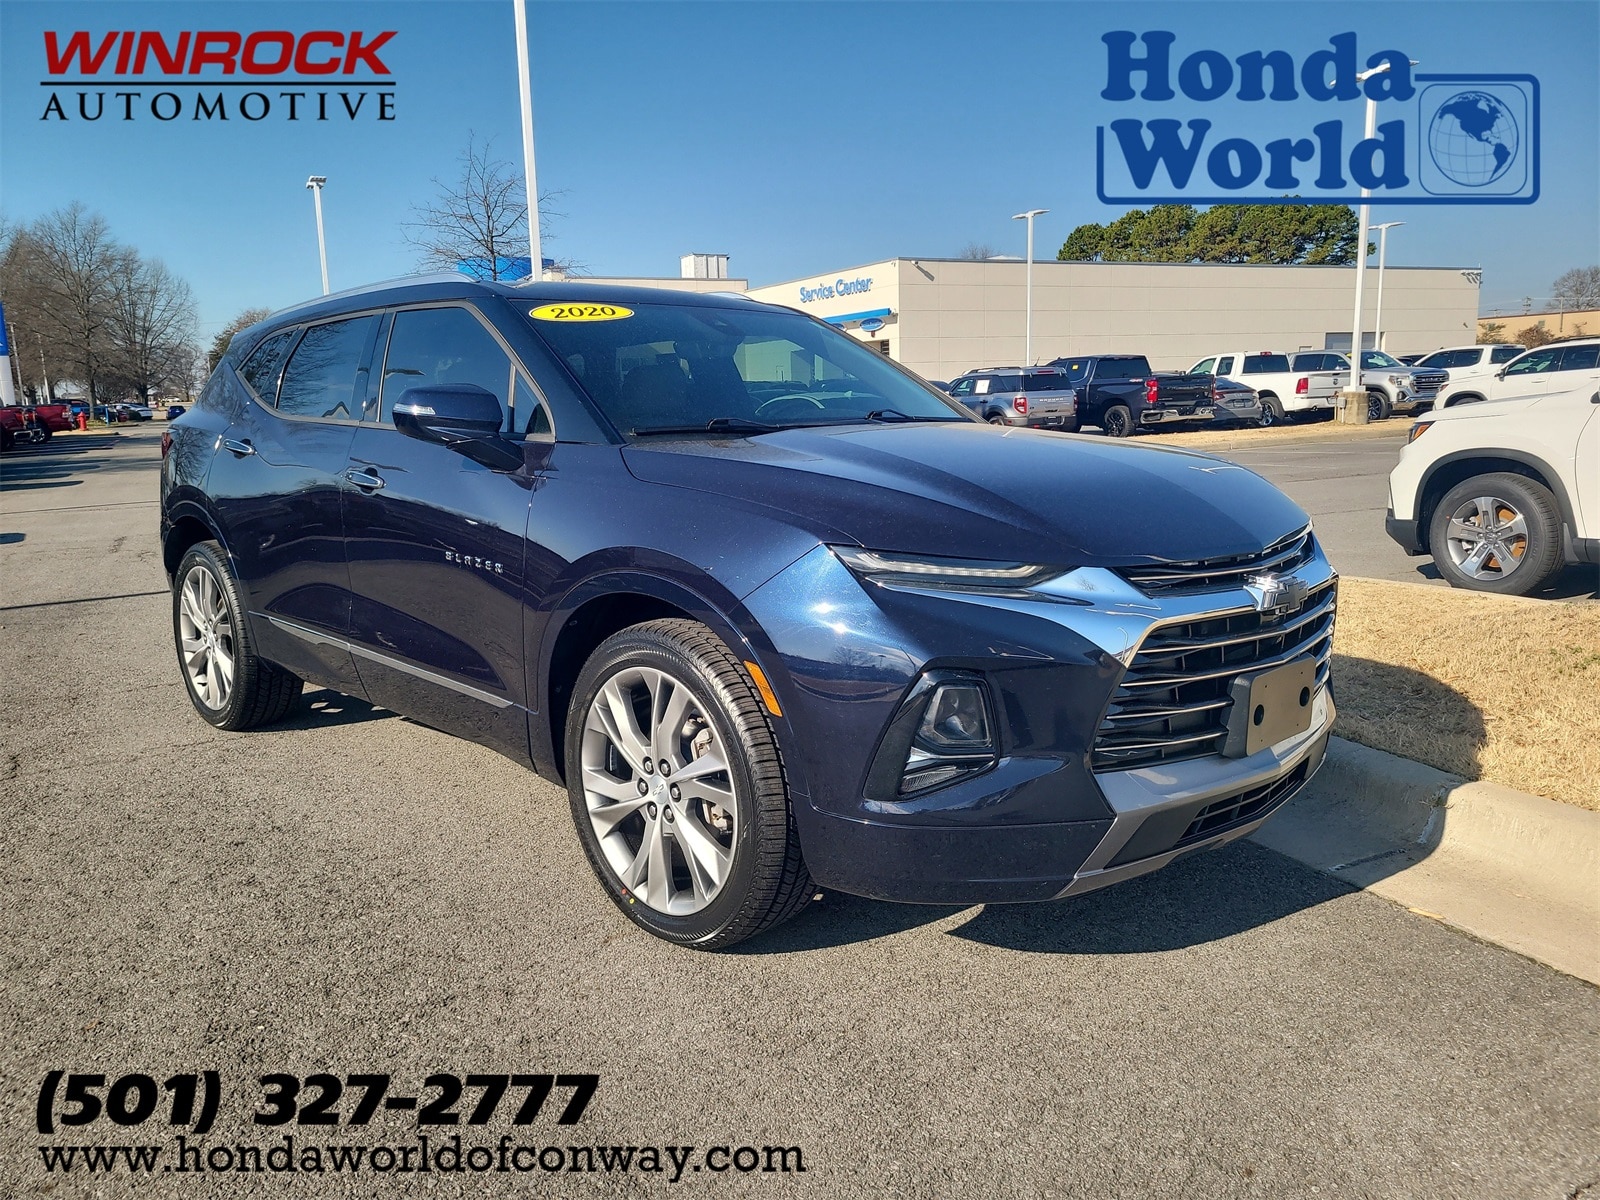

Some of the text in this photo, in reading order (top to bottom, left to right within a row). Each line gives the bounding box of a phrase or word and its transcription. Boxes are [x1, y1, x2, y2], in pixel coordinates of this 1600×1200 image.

[800, 277, 873, 303] Service Center
[551, 306, 616, 318] 2020
[445, 551, 504, 574] BLAZER
